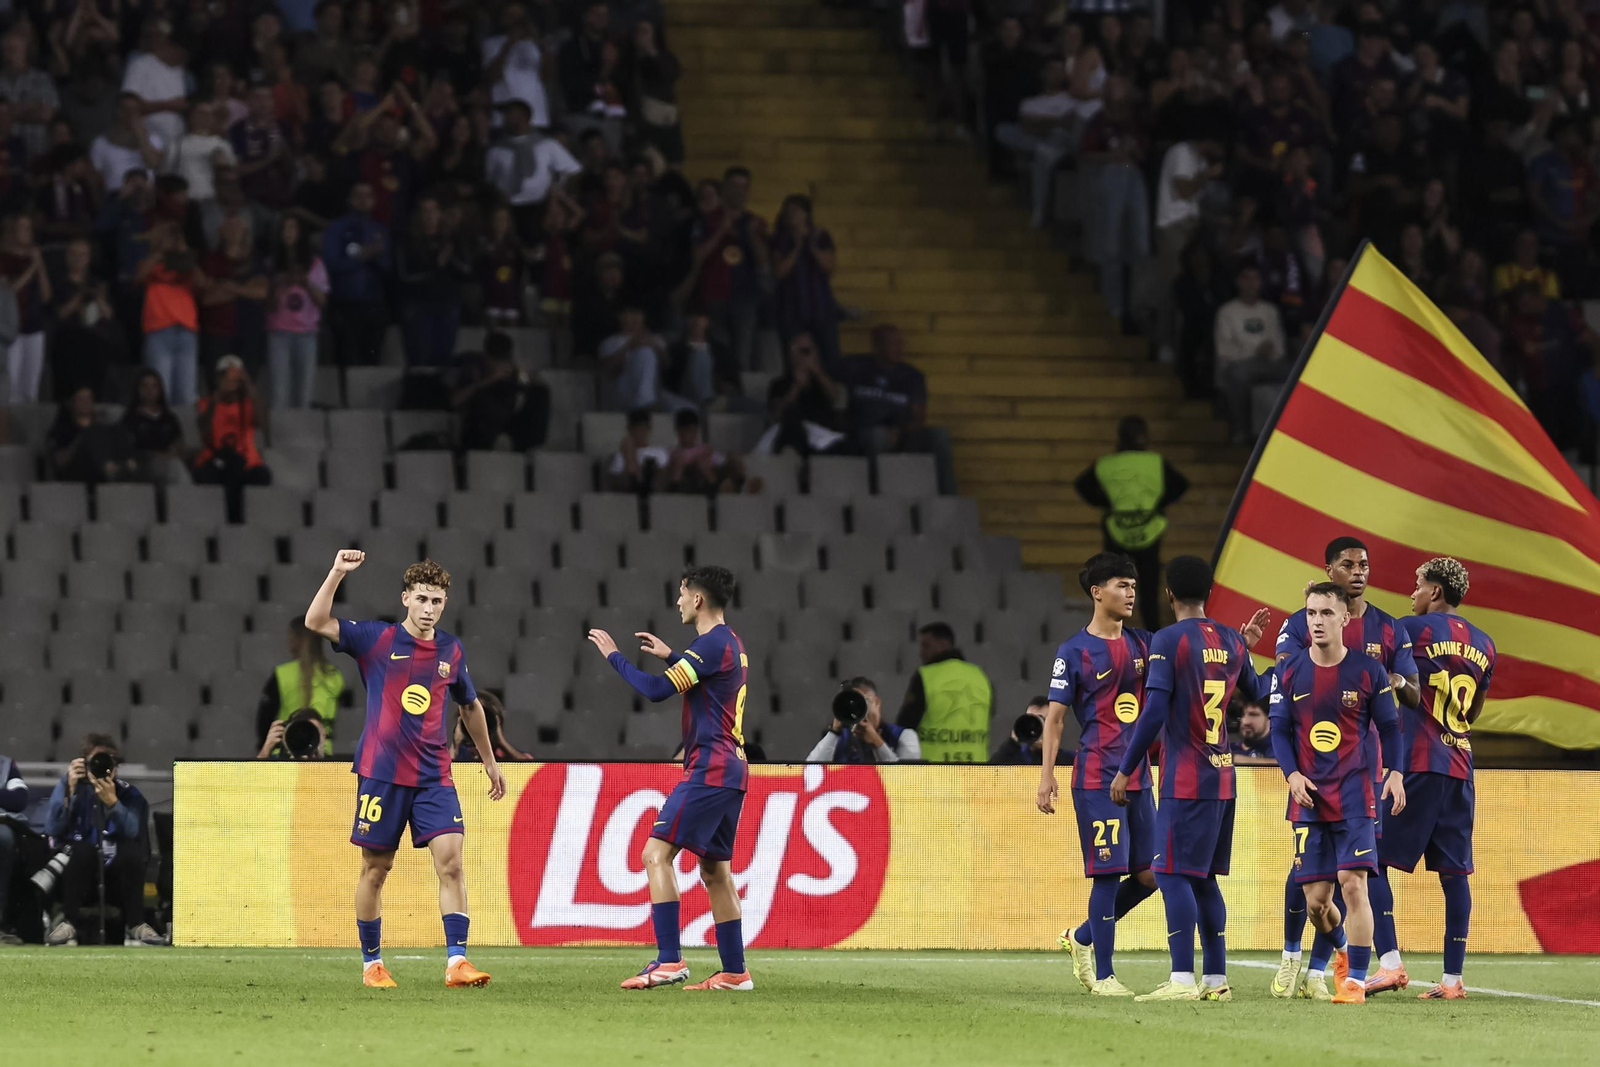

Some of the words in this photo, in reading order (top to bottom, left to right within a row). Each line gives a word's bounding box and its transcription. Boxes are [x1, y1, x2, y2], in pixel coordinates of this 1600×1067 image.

[1202, 648, 1228, 665] BALDE
[1425, 641, 1462, 659] LAMINE
[1203, 680, 1226, 745] 3
[1429, 669, 1477, 734] 10
[919, 727, 987, 744] SECURITY
[359, 794, 382, 823] 16
[1093, 819, 1120, 847] 27
[531, 763, 870, 947] Lay's
